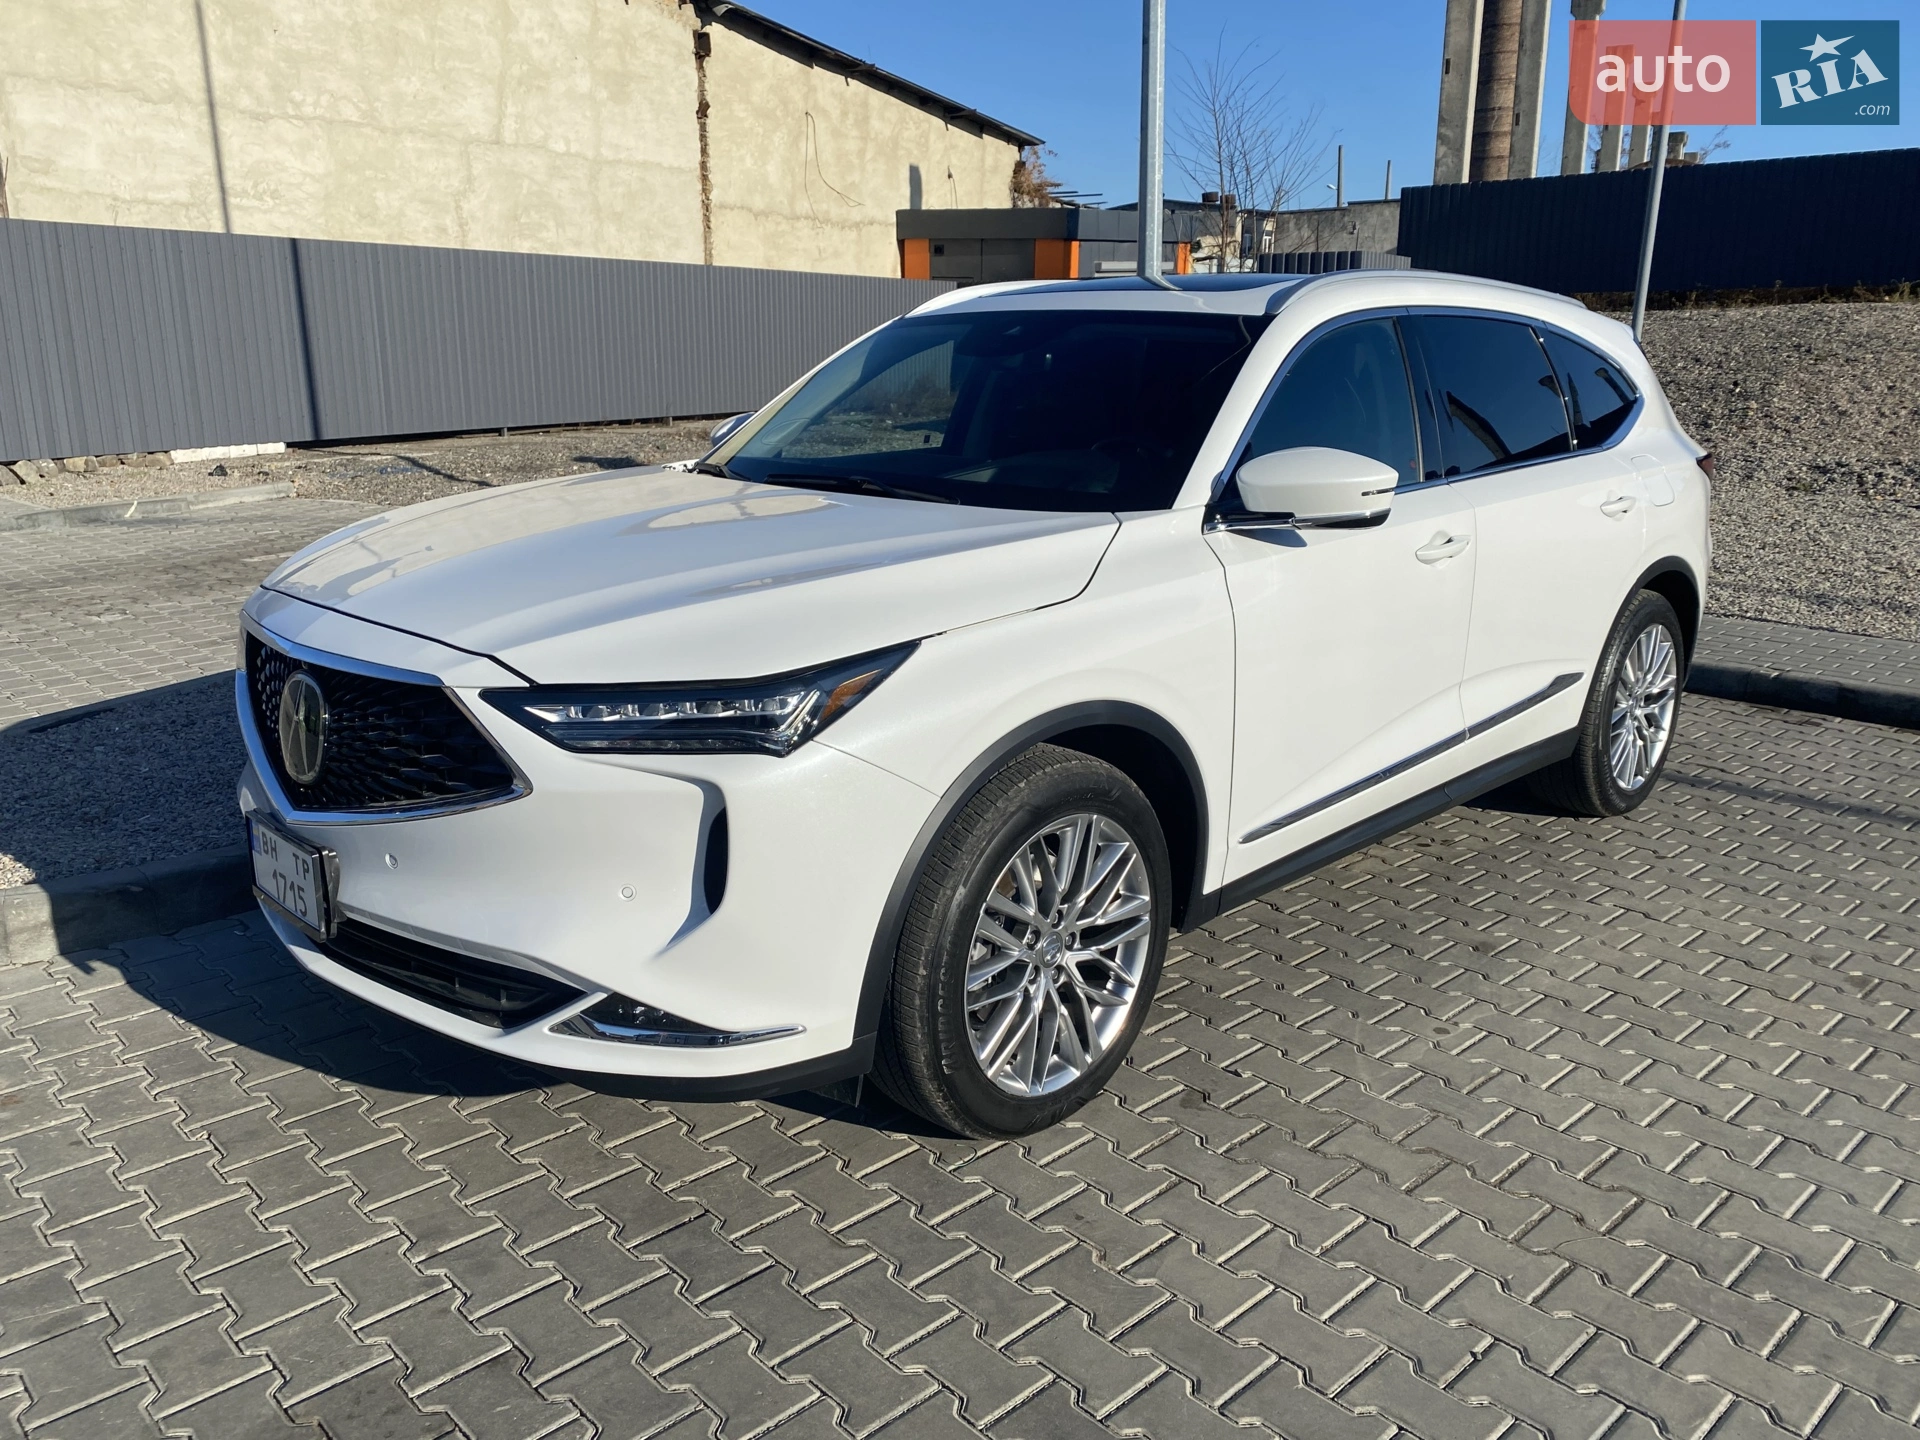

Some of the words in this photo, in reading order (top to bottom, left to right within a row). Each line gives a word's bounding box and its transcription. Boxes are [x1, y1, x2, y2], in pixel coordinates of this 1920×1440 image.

[262, 832, 278, 862] BH
[293, 853, 310, 880] TP
[272, 869, 308, 917] 1715
